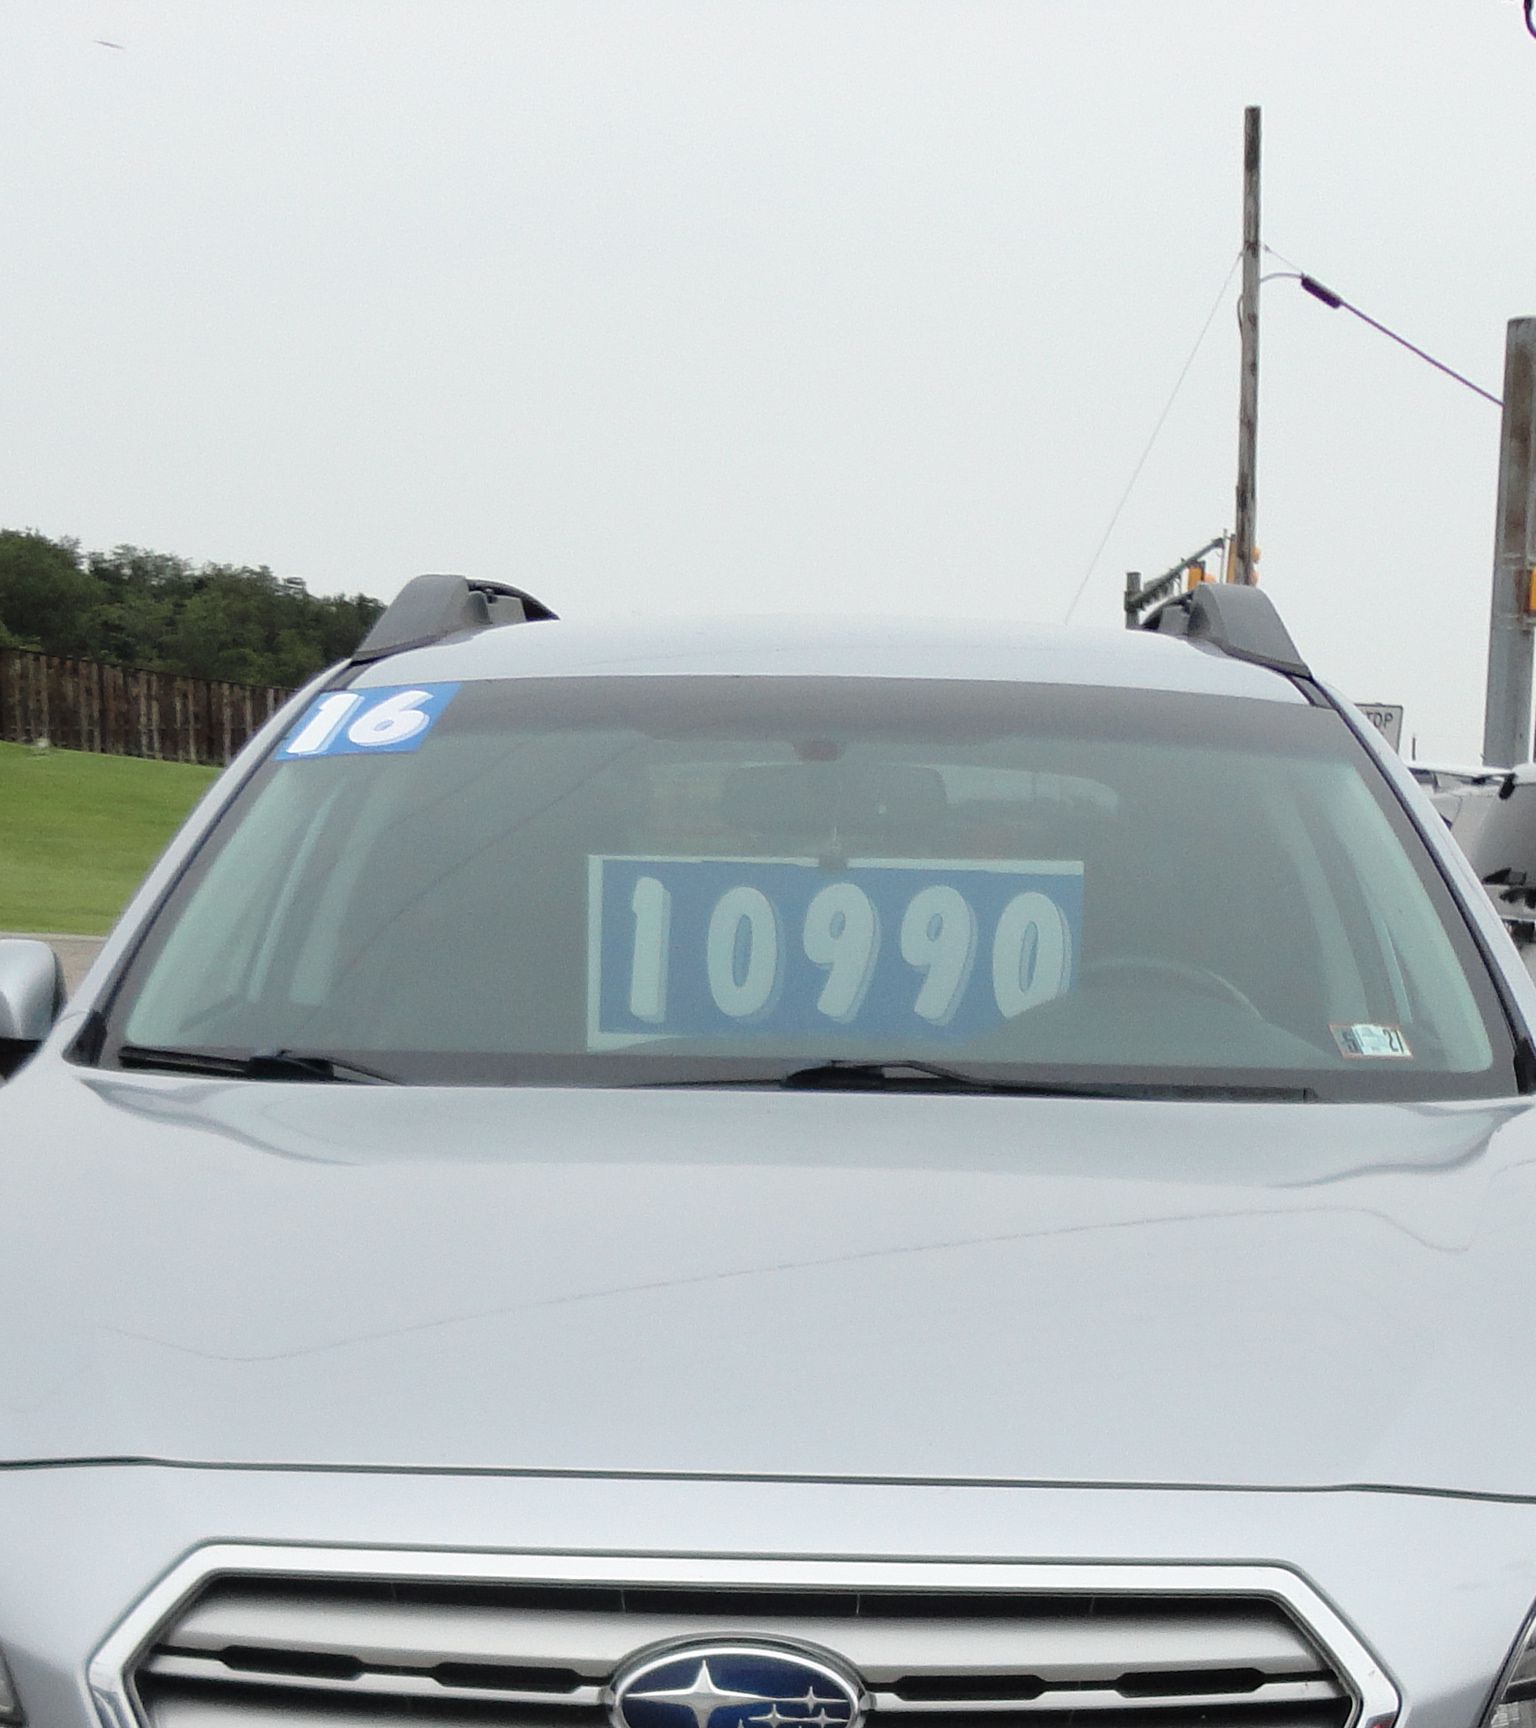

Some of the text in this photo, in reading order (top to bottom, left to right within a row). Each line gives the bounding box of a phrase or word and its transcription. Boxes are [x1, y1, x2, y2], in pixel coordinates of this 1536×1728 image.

[286, 689, 435, 756] 16
[1366, 711, 1393, 729] TOP
[629, 876, 1073, 1027] 10990
